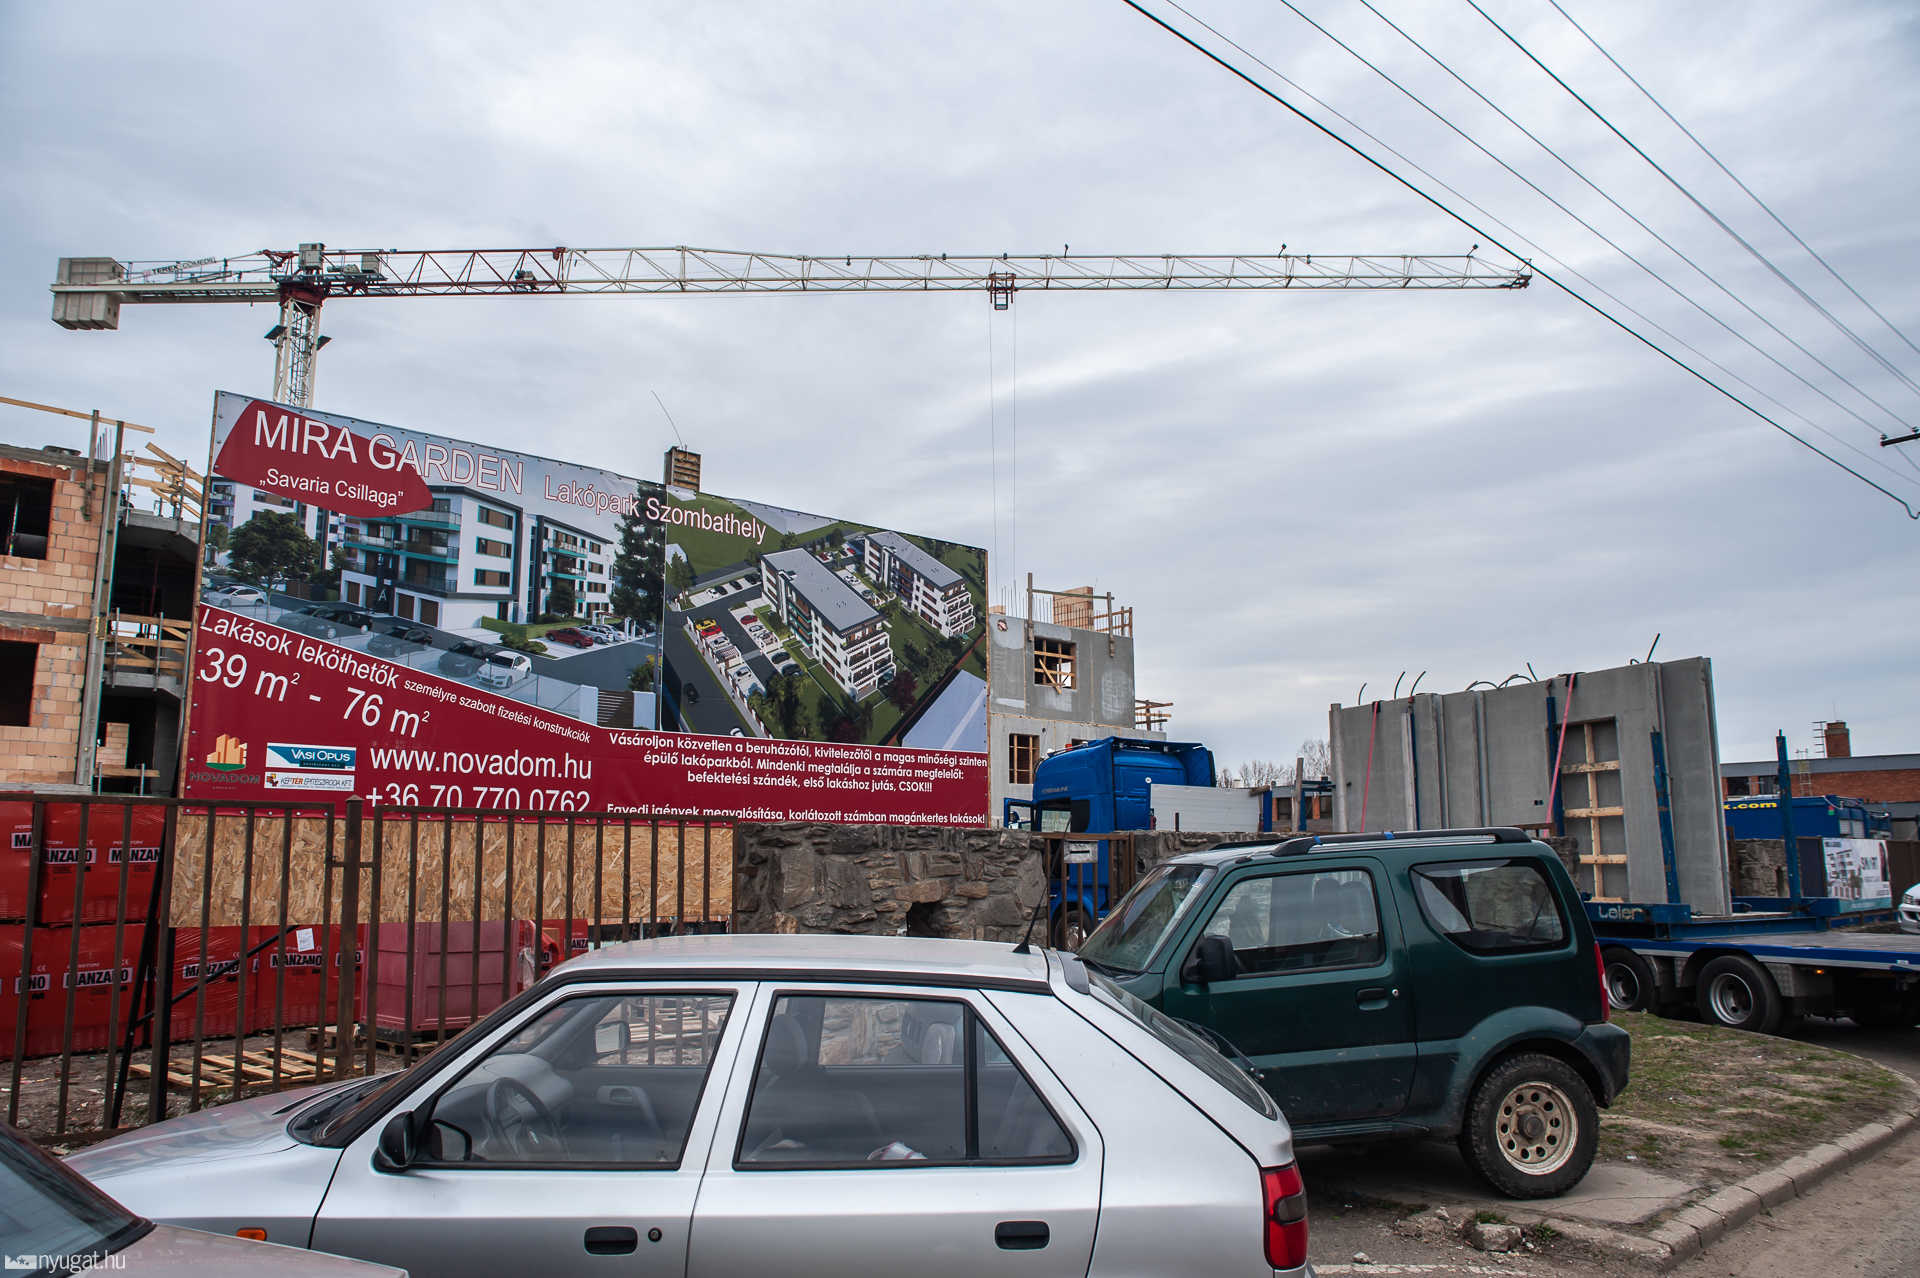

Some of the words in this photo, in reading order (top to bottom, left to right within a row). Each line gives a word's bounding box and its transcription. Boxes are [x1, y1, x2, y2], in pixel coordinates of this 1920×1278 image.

[254, 410, 358, 464] MIRA
[368, 433, 524, 495] GARDEN
[544, 475, 640, 518] Lakópark
[646, 497, 766, 545] Szombathely
[200, 608, 293, 656] Lakások
[296, 639, 400, 689] leköthetők
[403, 679, 458, 703] személyre
[459, 696, 496, 715] szabott
[497, 705, 532, 726] fizetési
[533, 716, 591, 744] konstrukciók
[200, 647, 248, 688] 39
[343, 686, 384, 727] 76
[370, 747, 592, 780] www.novadom.hu
[609, 732, 674, 749] Vásároljon
[677, 737, 732, 752] közvetlen
[735, 743, 743, 753] a
[746, 742, 812, 758] beruházótól,
[814, 747, 872, 761] kivitelezőtől
[875, 752, 881, 761] a
[884, 752, 915, 766] magas
[918, 754, 958, 767] minőségi
[959, 756, 987, 768] szinten
[644, 751, 679, 766] épülő
[681, 754, 753, 769] lakóparkból.
[756, 759, 806, 772] Mindenki
[808, 761, 861, 776] megtalálja
[863, 767, 871, 776] a
[873, 766, 912, 777] számára
[189, 771, 260, 785] NOVADOM
[687, 770, 751, 785] befektetési
[753, 774, 800, 788] szándék,
[803, 776, 824, 787] első
[826, 777, 870, 790] lakáshoz
[871, 780, 896, 792] jutás,
[899, 781, 932, 792] CSOK!!!
[366, 783, 419, 807] +36
[430, 785, 463, 809] 70
[473, 786, 520, 810] 770
[529, 788, 590, 812] 0762
[789, 808, 842, 822] korlátozott
[844, 811, 886, 822] számban
[889, 812, 948, 825] magánkertes
[950, 813, 985, 825] lakások!
